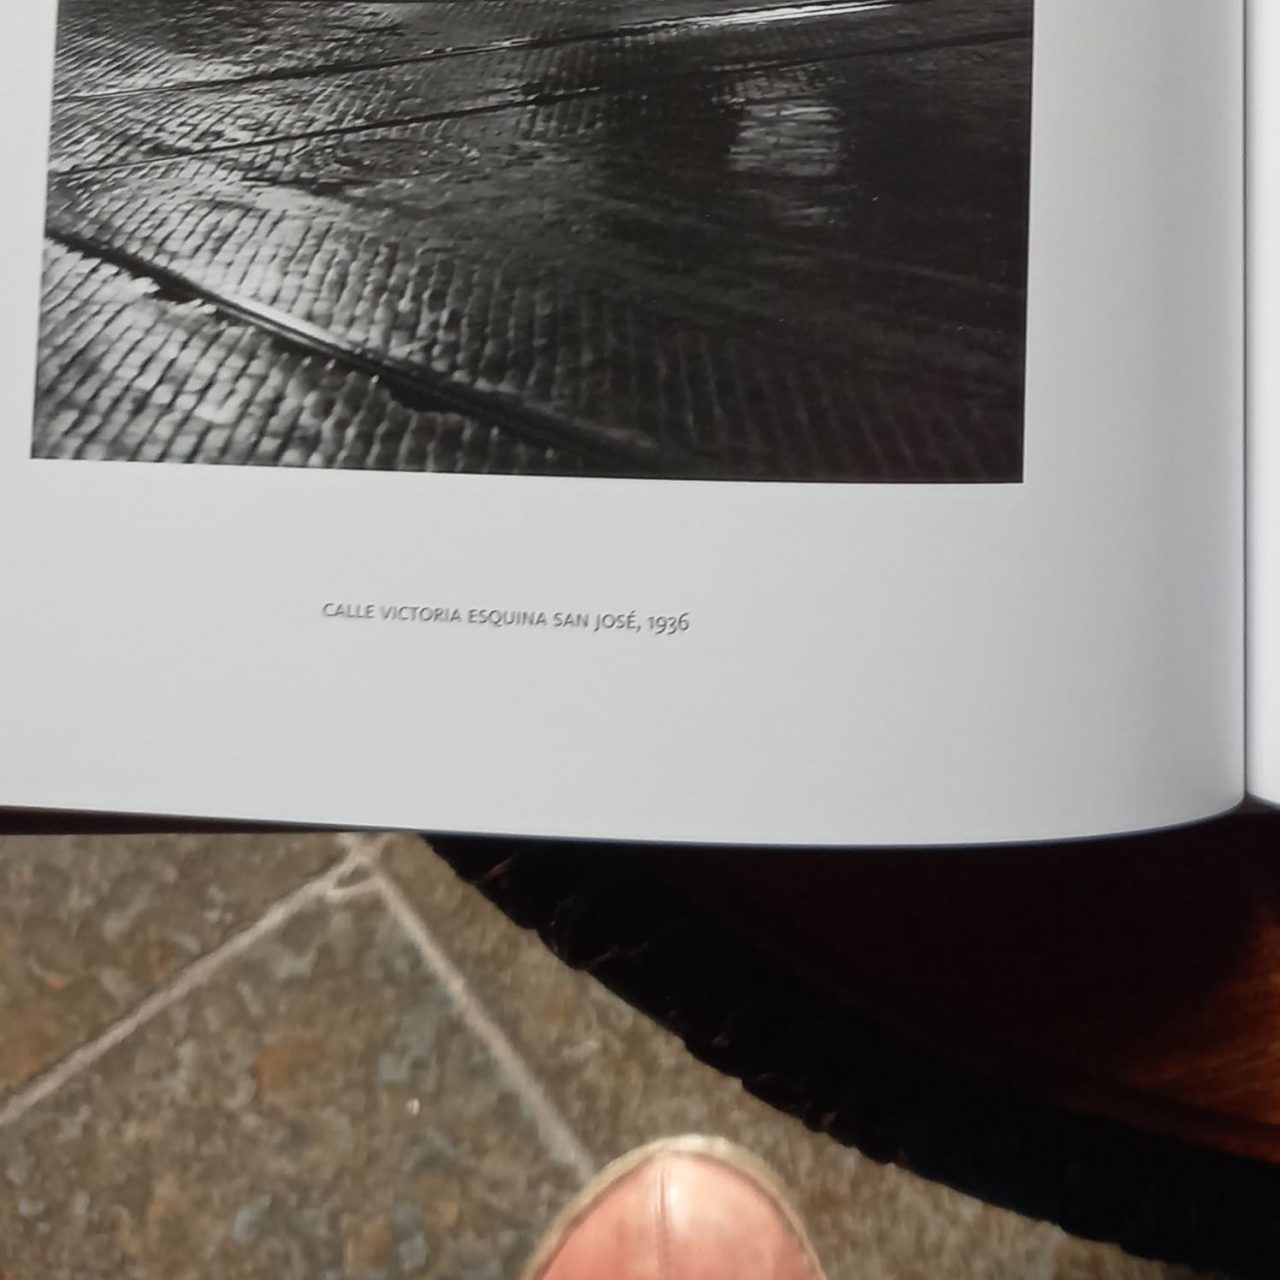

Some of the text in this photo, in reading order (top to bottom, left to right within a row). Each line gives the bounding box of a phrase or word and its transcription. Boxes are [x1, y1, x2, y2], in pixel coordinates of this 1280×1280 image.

[322, 602, 691, 635] CALLE VICTORIA ESQUINA SAN JOSÉ, 1936
